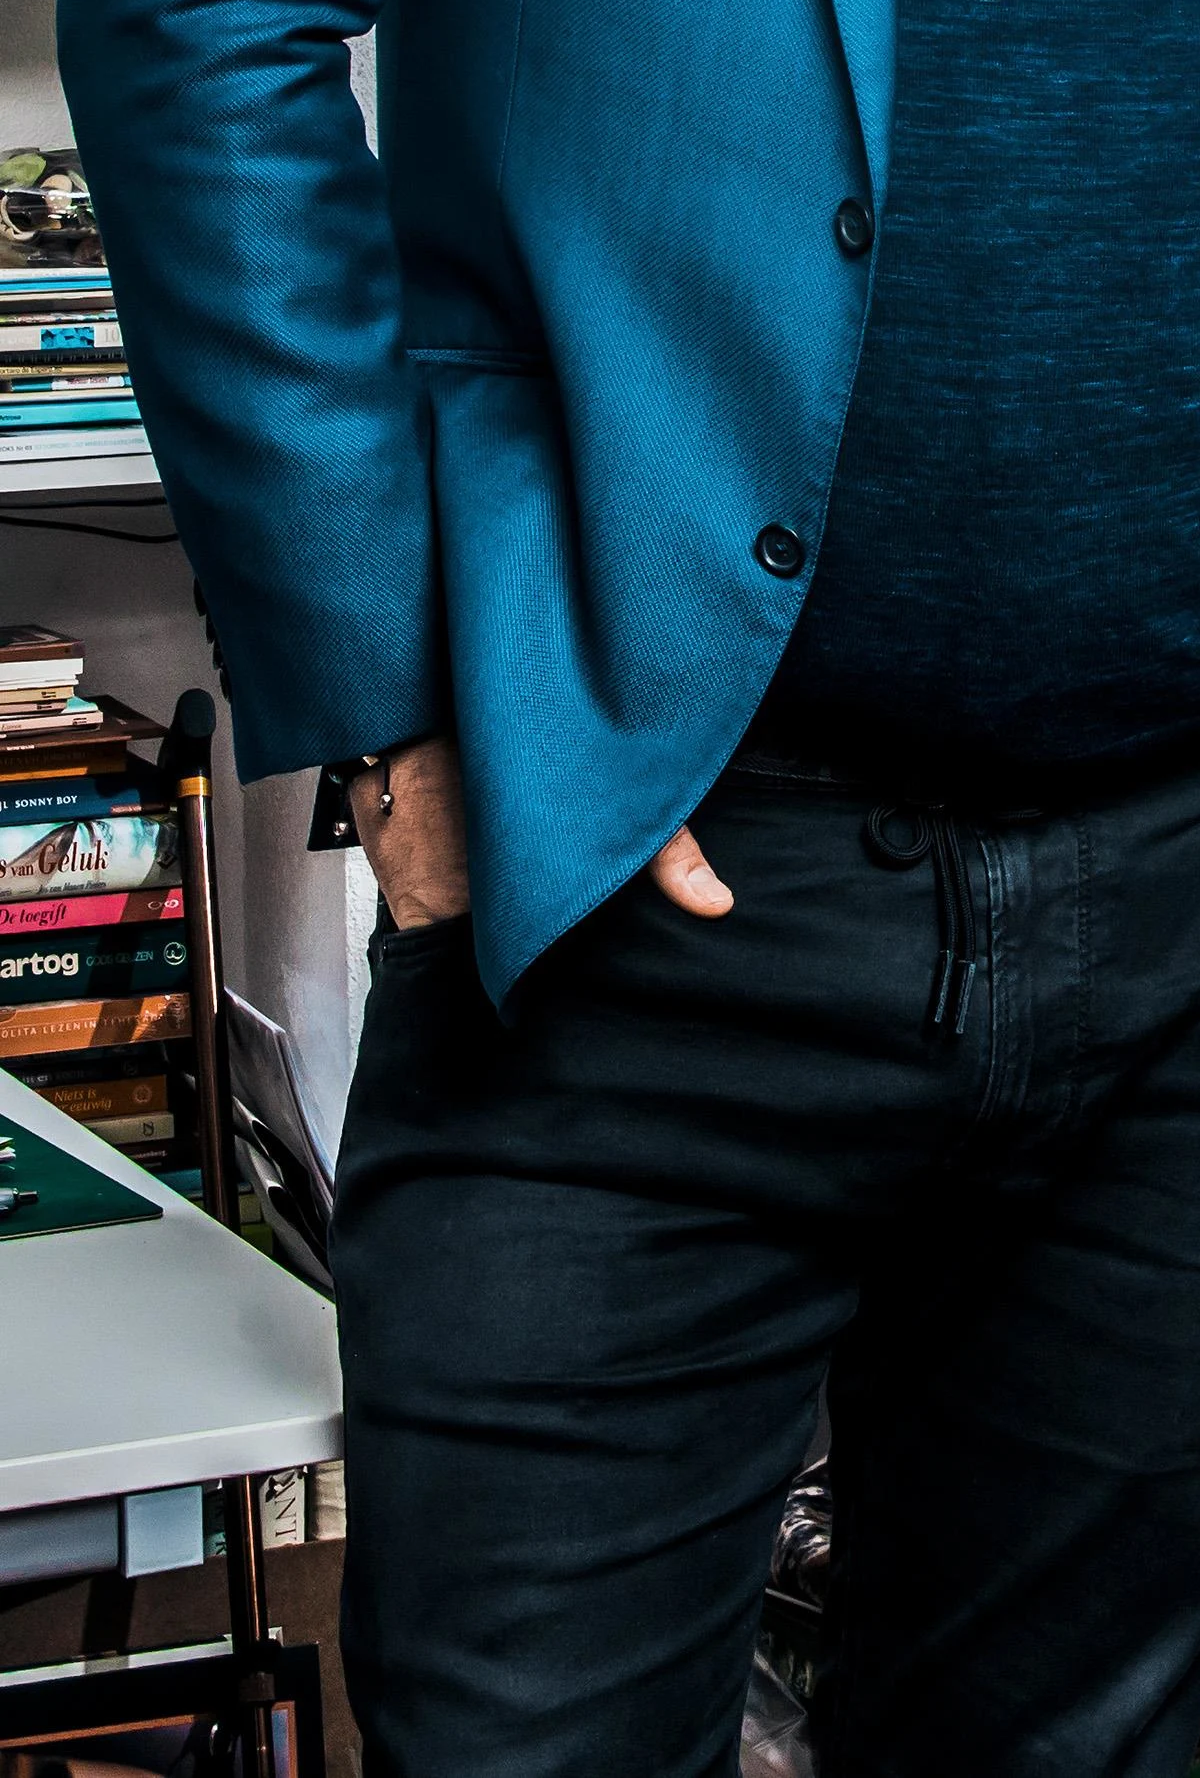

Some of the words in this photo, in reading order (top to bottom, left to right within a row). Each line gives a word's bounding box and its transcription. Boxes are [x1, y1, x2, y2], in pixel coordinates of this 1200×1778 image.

[15, 797, 52, 808] SONNY
[56, 795, 78, 805] BOY
[11, 863, 34, 877] van
[38, 840, 108, 874] Geluk
[0, 908, 16, 924] De
[20, 904, 67, 926] toegift
[0, 952, 79, 979] artog
[43, 1022, 81, 1034] LEZEN
[84, 1021, 96, 1029] IN
[55, 1089, 85, 1103] Niets
[88, 1088, 97, 1097] is
[70, 1097, 113, 1112] eeuwig
